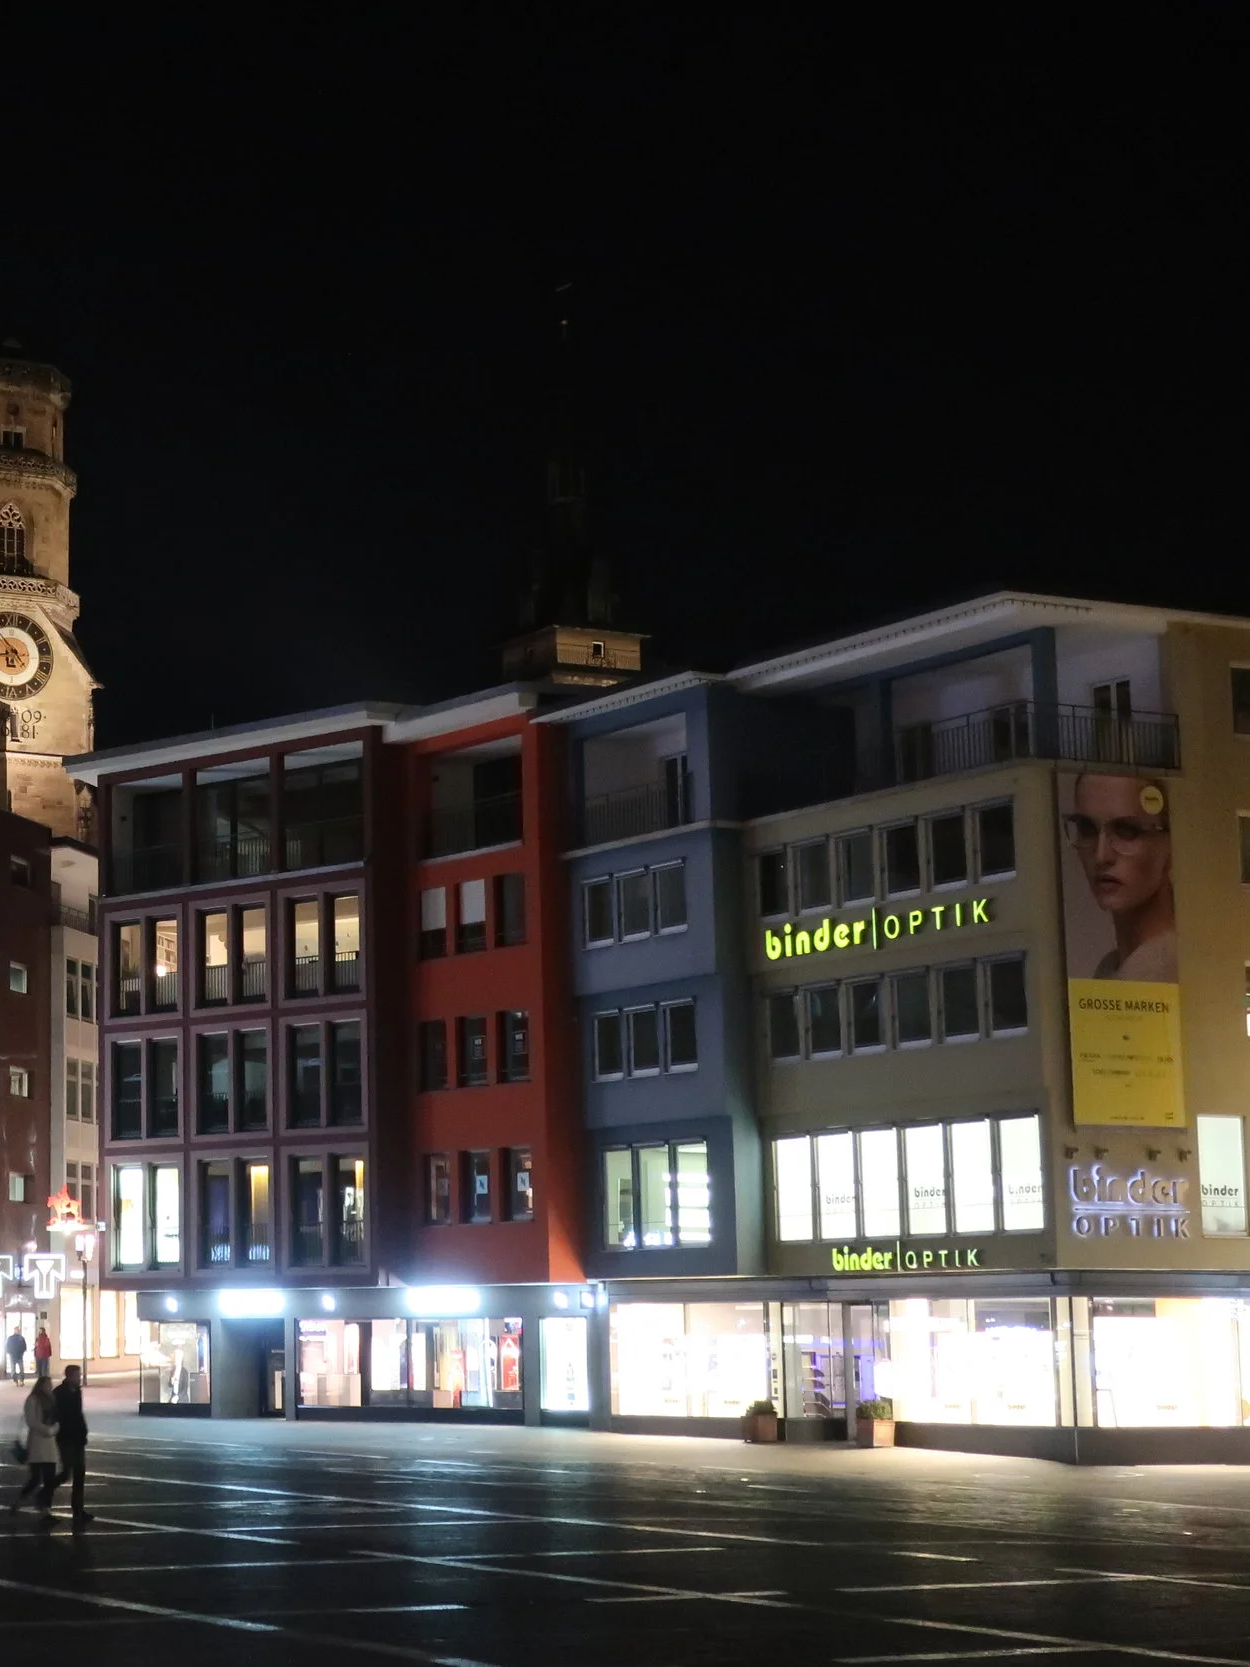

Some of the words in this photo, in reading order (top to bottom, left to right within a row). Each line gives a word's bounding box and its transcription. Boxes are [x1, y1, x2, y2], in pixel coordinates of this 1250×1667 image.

[765, 918, 867, 961] binder
[884, 898, 989, 940] OPTIK
[1078, 997, 1122, 1012] GROSSE
[1125, 999, 1170, 1014] MARKEN
[1070, 1164, 1190, 1204] binder
[1201, 1183, 1239, 1197] binder
[1072, 1214, 1190, 1238] OPTIK
[832, 1246, 892, 1271] binder
[905, 1247, 980, 1269] OPTIK
